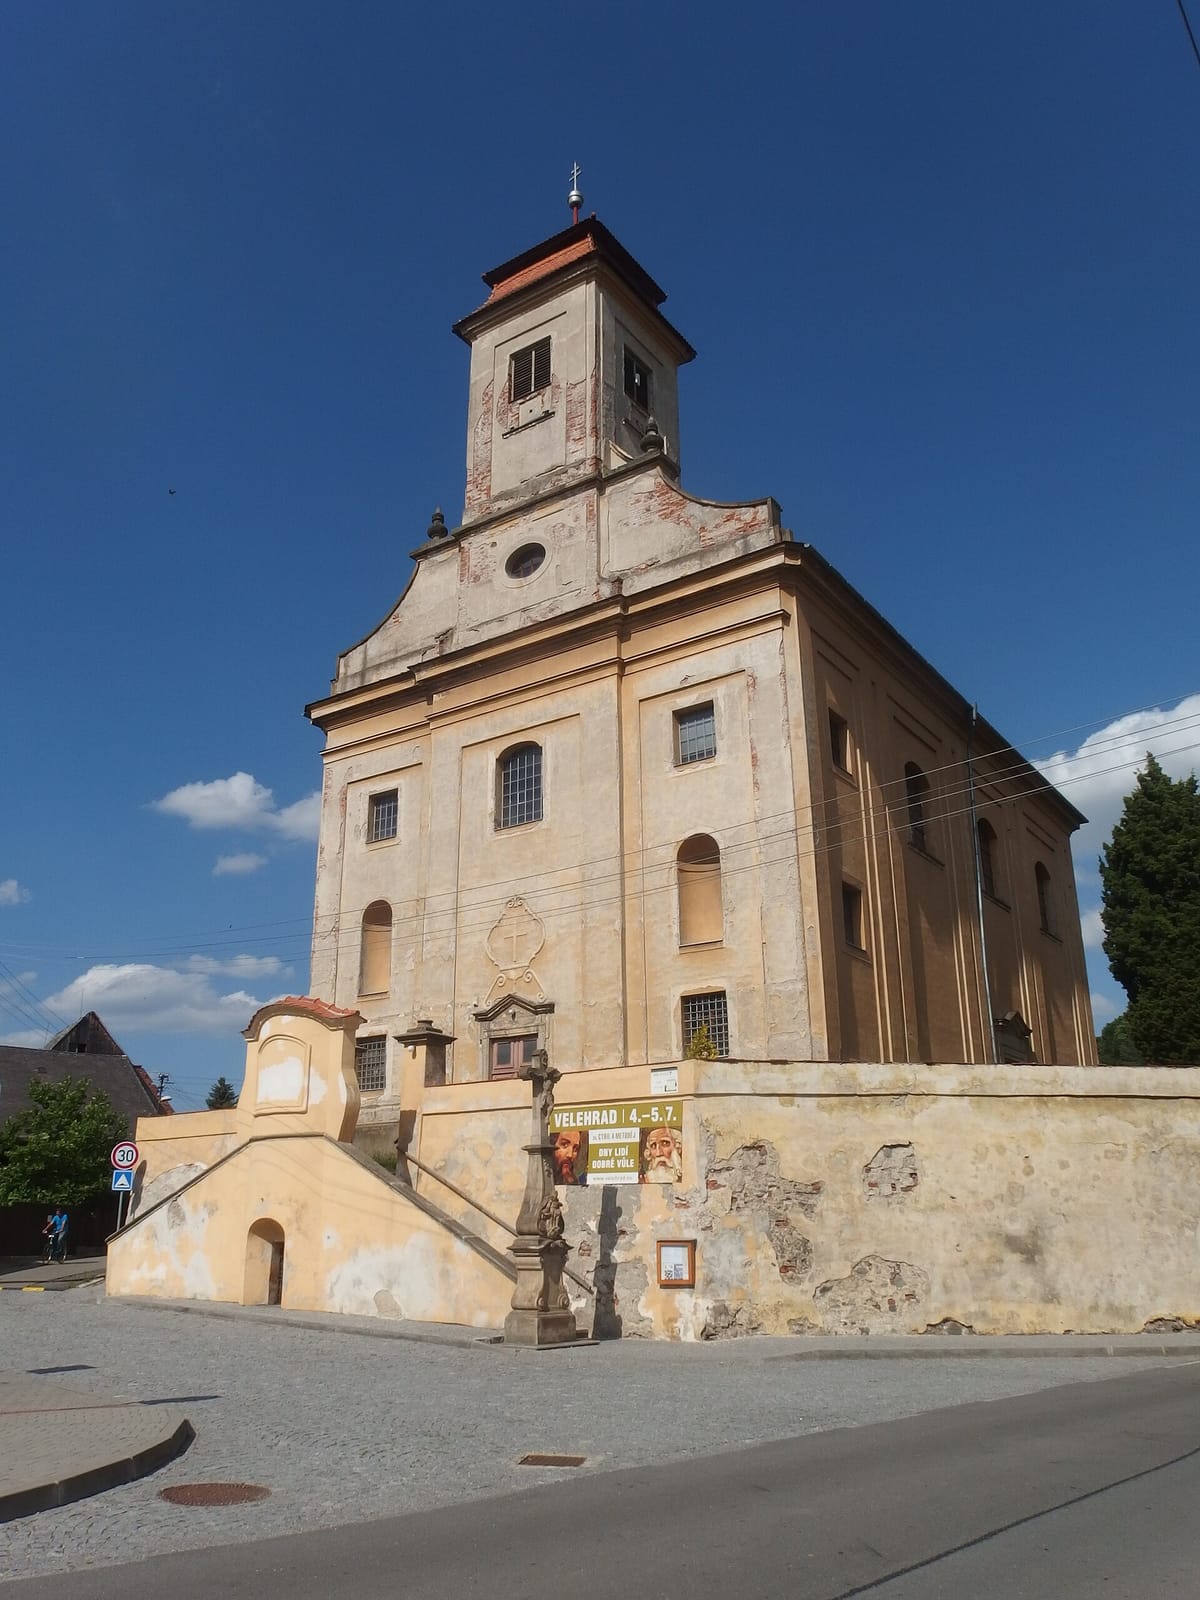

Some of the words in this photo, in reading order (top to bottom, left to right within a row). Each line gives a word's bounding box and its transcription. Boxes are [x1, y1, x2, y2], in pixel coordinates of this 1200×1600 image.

[554, 1109, 618, 1128] VELEHRAD
[117, 1149, 134, 1162] 30
[598, 1147, 613, 1157] DNY
[614, 1145, 629, 1157] LIDÍ
[592, 1157, 615, 1169] DOBRÉ
[616, 1157, 635, 1168] VŮLE
